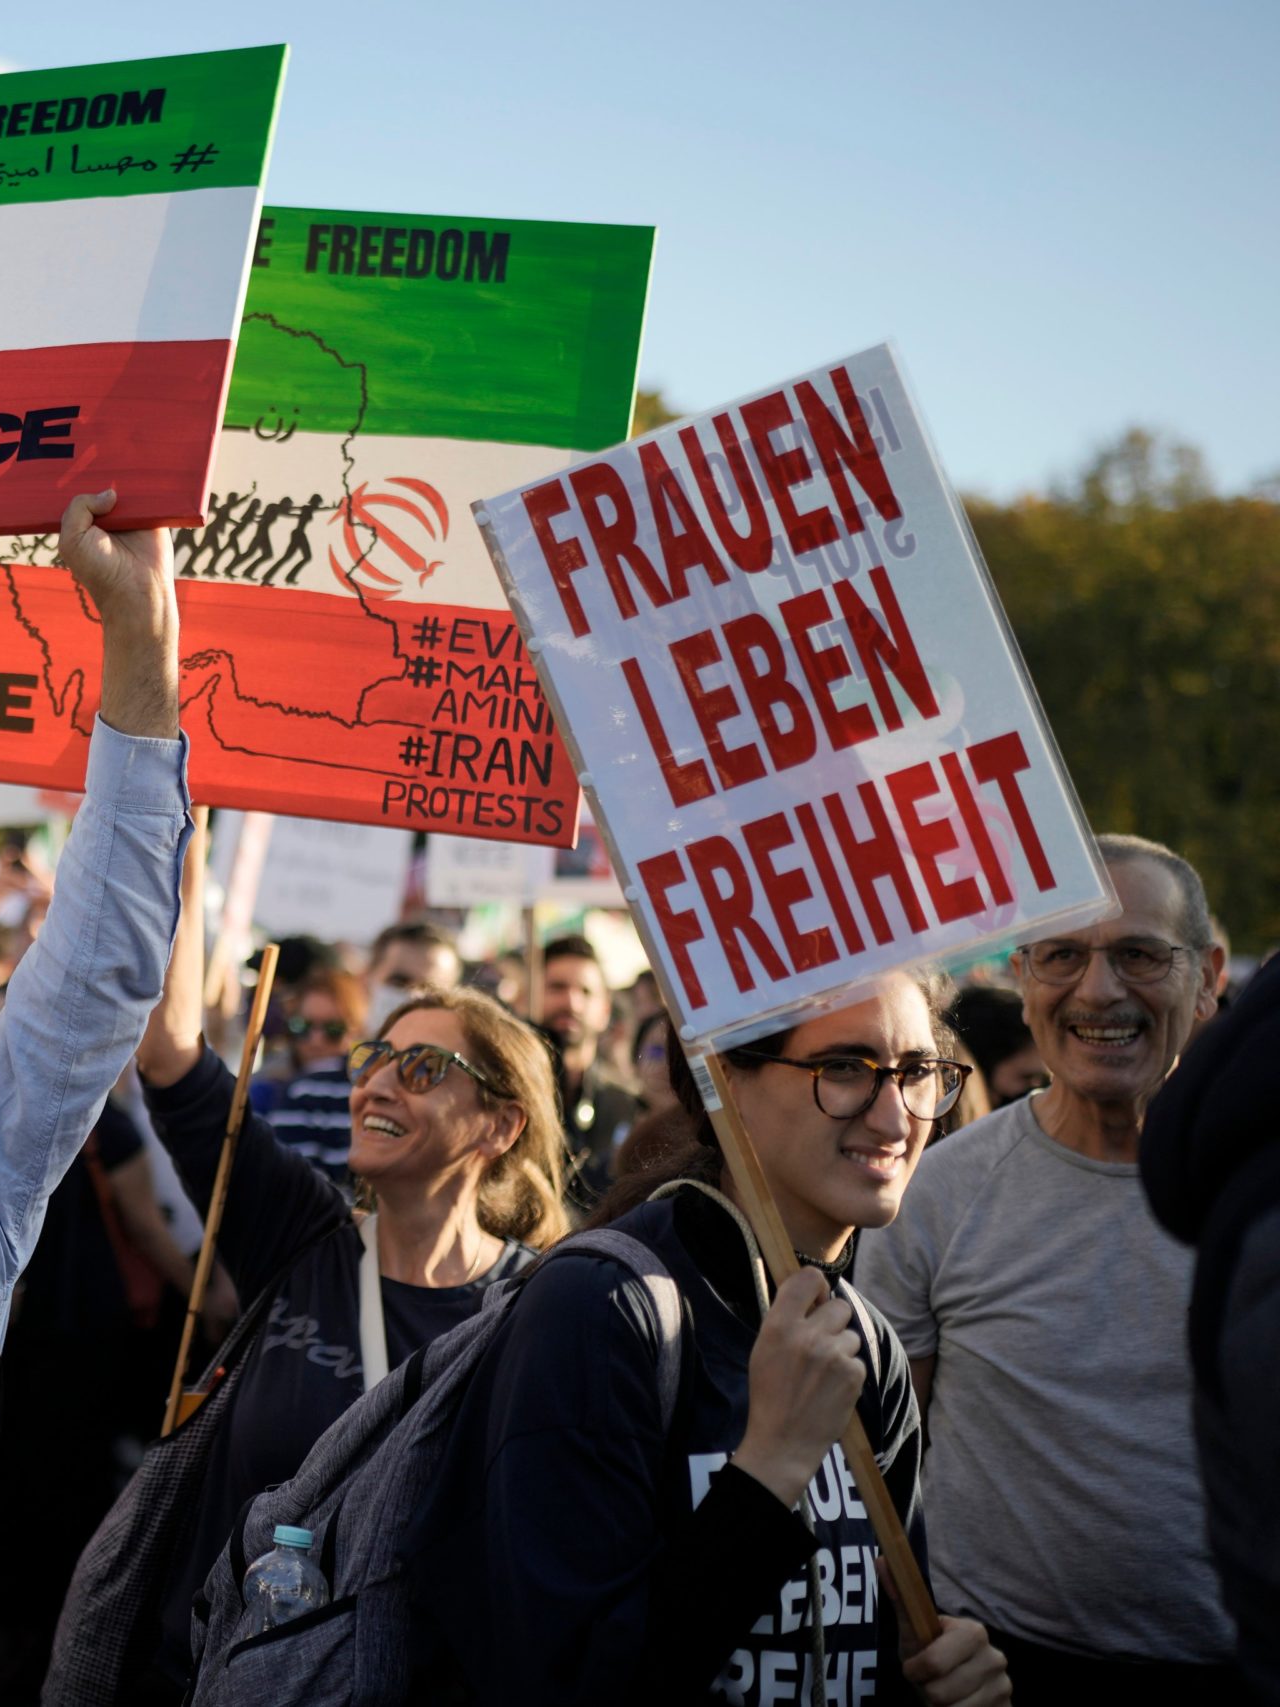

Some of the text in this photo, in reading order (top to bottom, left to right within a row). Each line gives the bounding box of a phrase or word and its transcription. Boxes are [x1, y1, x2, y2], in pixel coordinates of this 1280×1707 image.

[304, 223, 512, 283] FREEDOM
[520, 365, 904, 638] FRAUEN
[411, 616, 526, 663] #EVI
[407, 656, 544, 699] #MAH
[621, 565, 941, 808] LEBEN
[399, 730, 553, 787] #IRAN
[382, 781, 564, 836] PROTESTS
[637, 731, 1057, 1010] FREIHEIT
